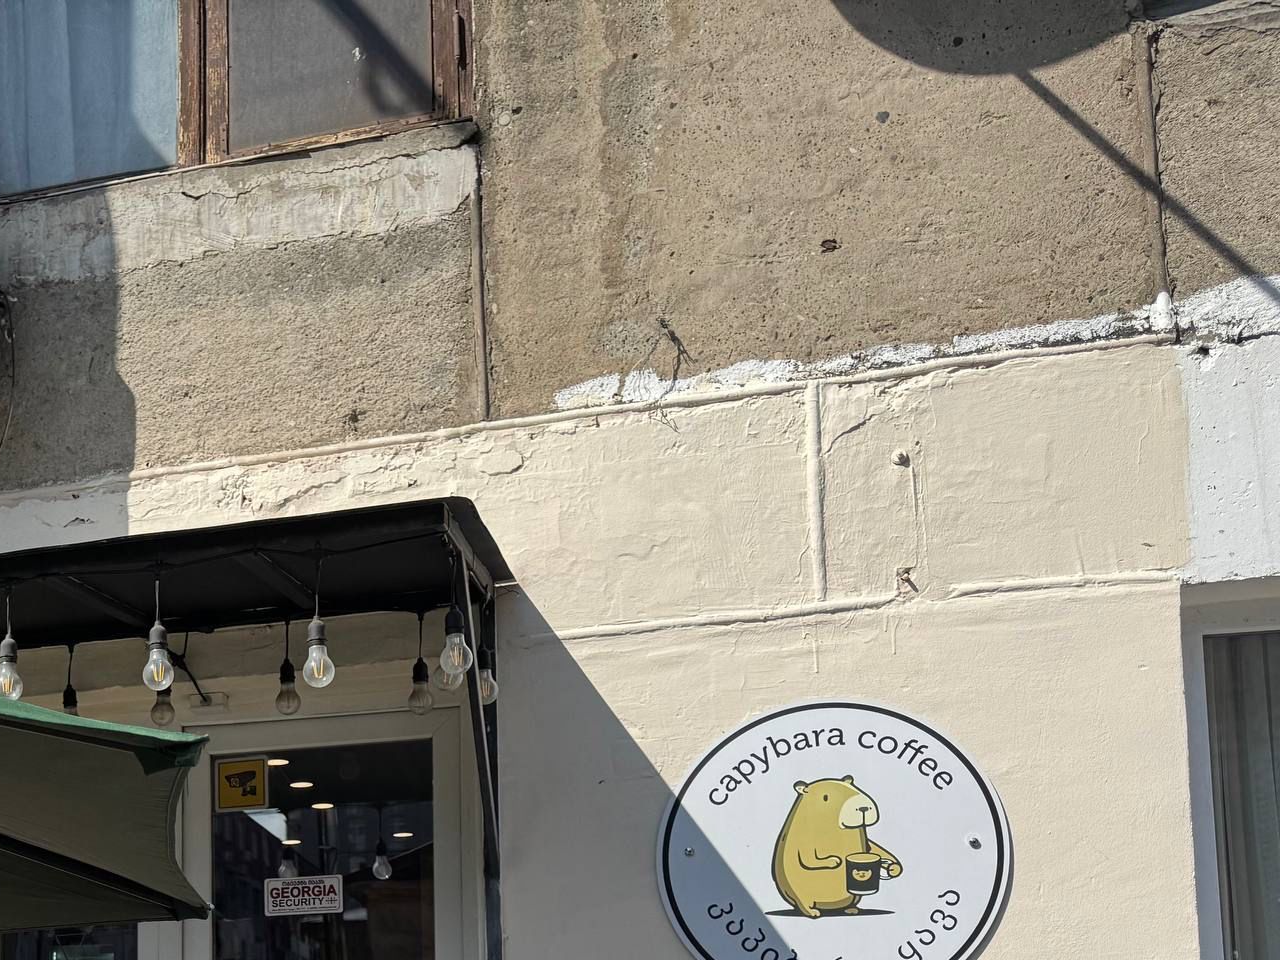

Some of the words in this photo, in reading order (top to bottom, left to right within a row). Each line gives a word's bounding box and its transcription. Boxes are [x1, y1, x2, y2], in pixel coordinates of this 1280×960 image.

[708, 727, 846, 806] capybara
[857, 729, 954, 791] coffee
[270, 884, 337, 899] GEORGIA
[272, 897, 325, 908] SECURITY
